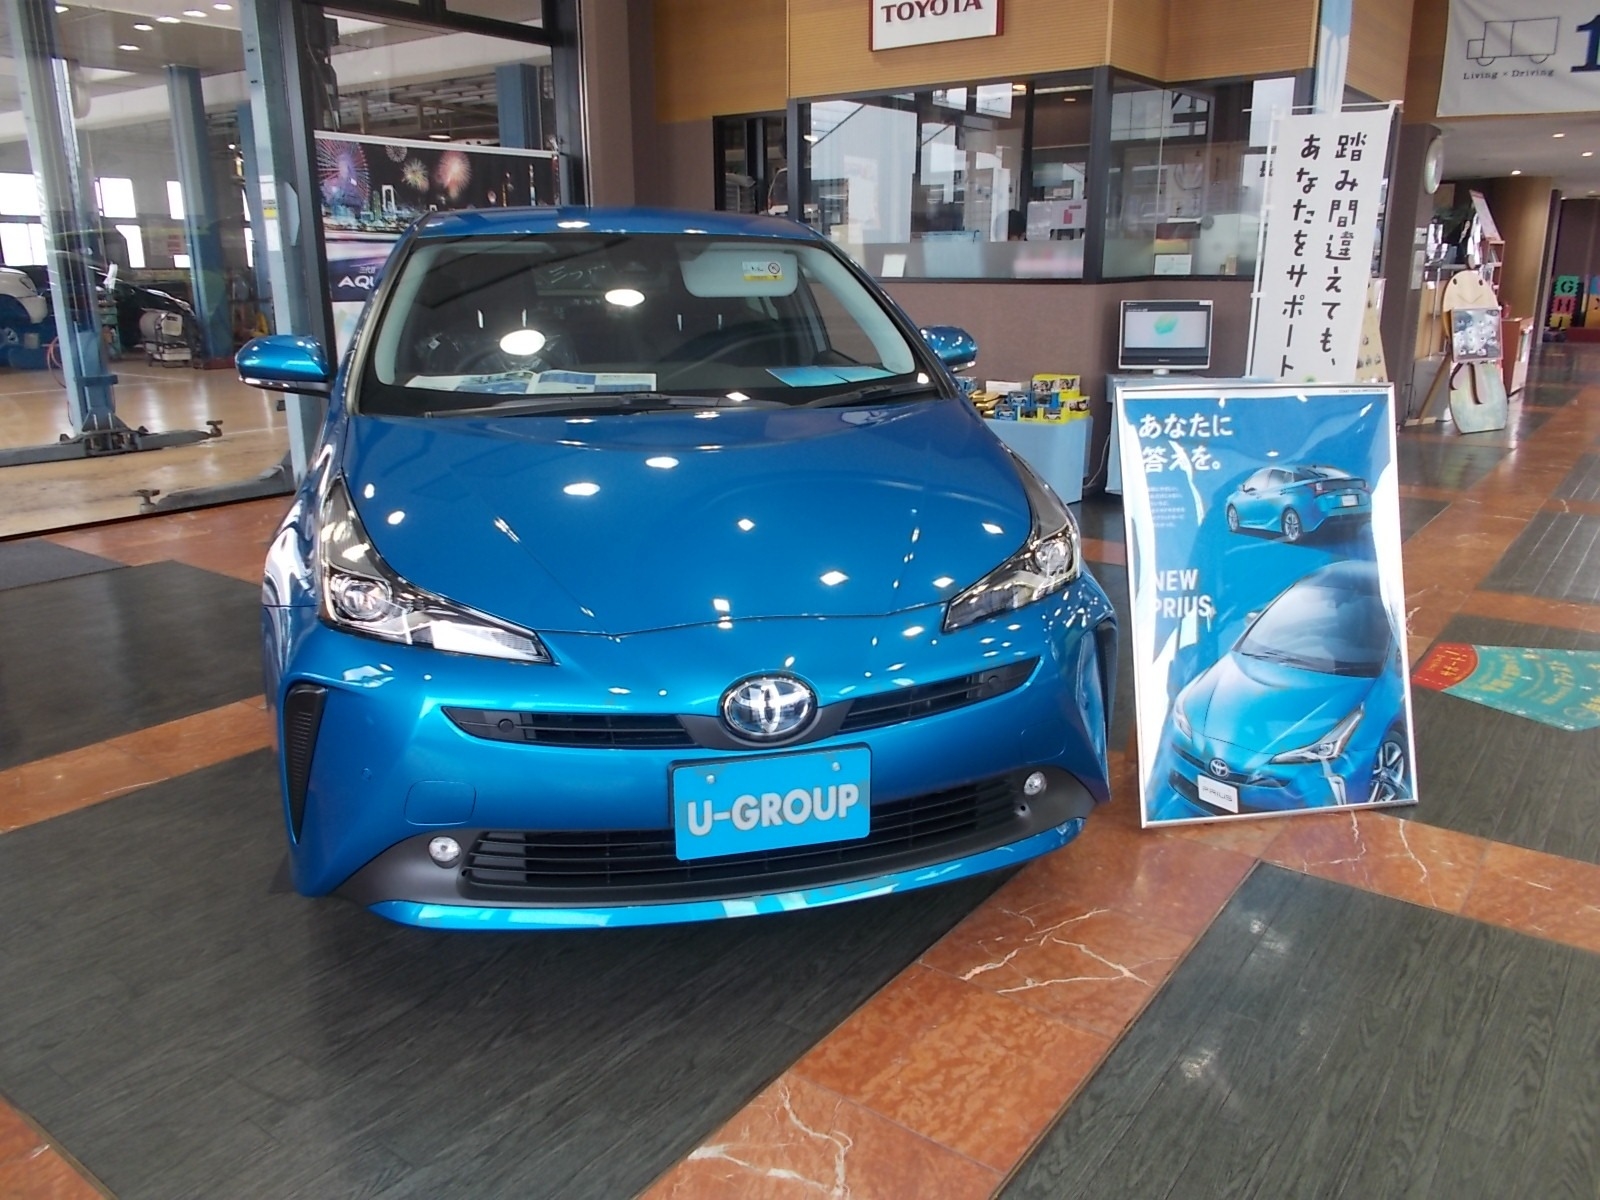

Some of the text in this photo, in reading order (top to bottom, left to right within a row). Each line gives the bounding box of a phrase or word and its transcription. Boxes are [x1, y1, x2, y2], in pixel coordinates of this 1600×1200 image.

[881, 0, 983, 23] TOYOTA
[1463, 71, 1499, 80] Living
[1511, 69, 1555, 78] Driving
[1280, 133, 1321, 378] あなたをサポート
[1320, 131, 1368, 366] 踏み間違えても、
[1138, 412, 1234, 440] あなたに
[1154, 568, 1199, 591] NEW
[687, 783, 860, 837] U-GROUP
